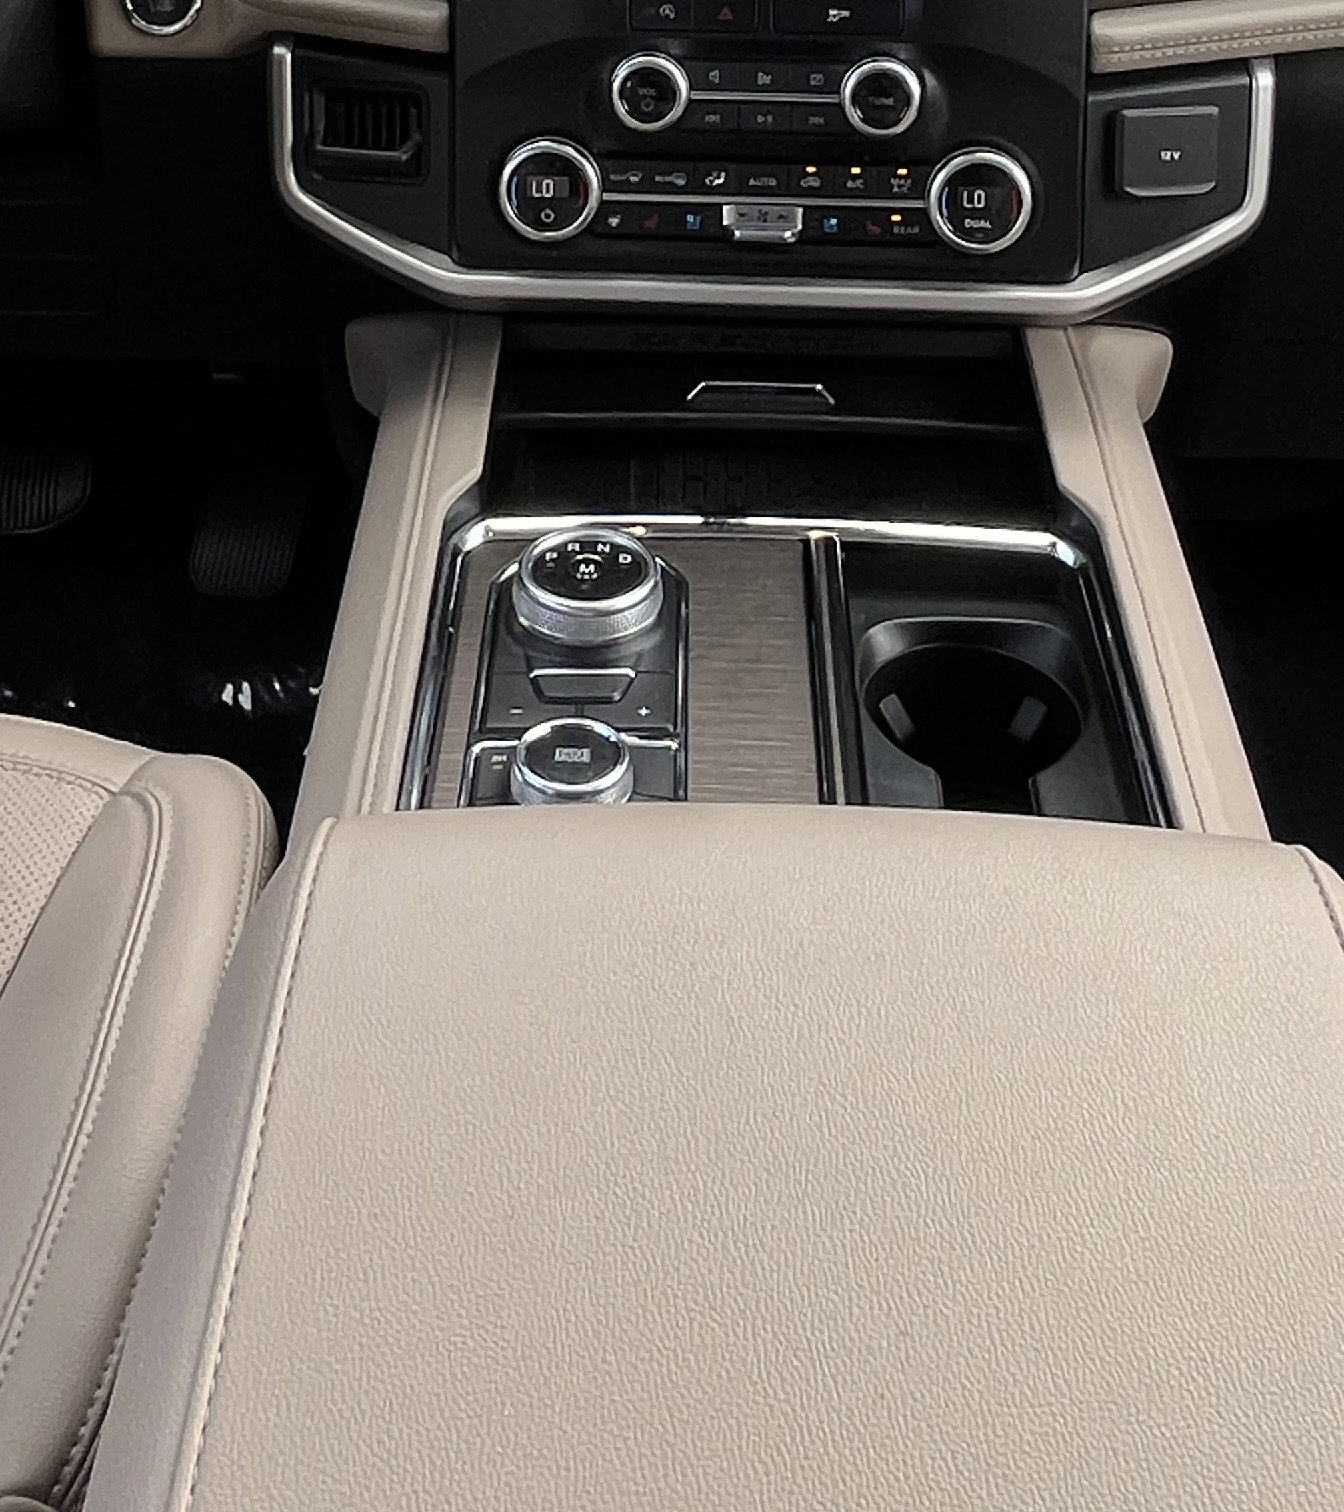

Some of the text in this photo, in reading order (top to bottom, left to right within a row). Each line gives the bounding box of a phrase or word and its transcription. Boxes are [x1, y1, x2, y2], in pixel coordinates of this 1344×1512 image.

[748, 176, 777, 187] AUTO
[532, 178, 555, 198] LO
[962, 189, 986, 209] LO
[964, 217, 992, 229] DUAL
[618, 553, 633, 565] D
